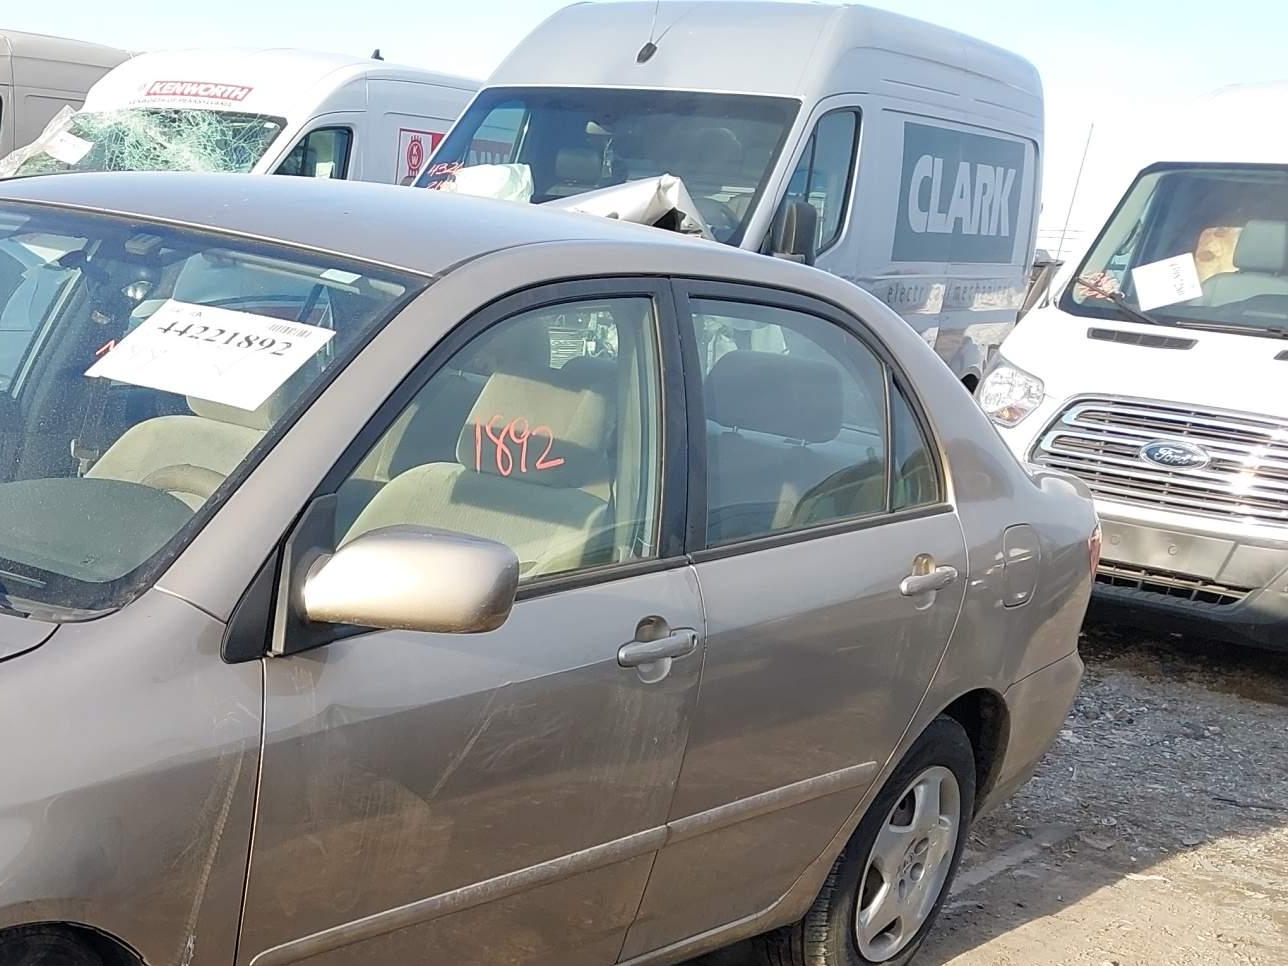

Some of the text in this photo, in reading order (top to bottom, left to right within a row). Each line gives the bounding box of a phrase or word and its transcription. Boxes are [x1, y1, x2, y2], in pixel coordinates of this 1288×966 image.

[149, 82, 249, 100] KENWORTH
[908, 154, 1017, 237] CLARK
[158, 321, 292, 356] 44221892
[474, 415, 565, 477] 1892
[1153, 447, 1193, 465] Ford
